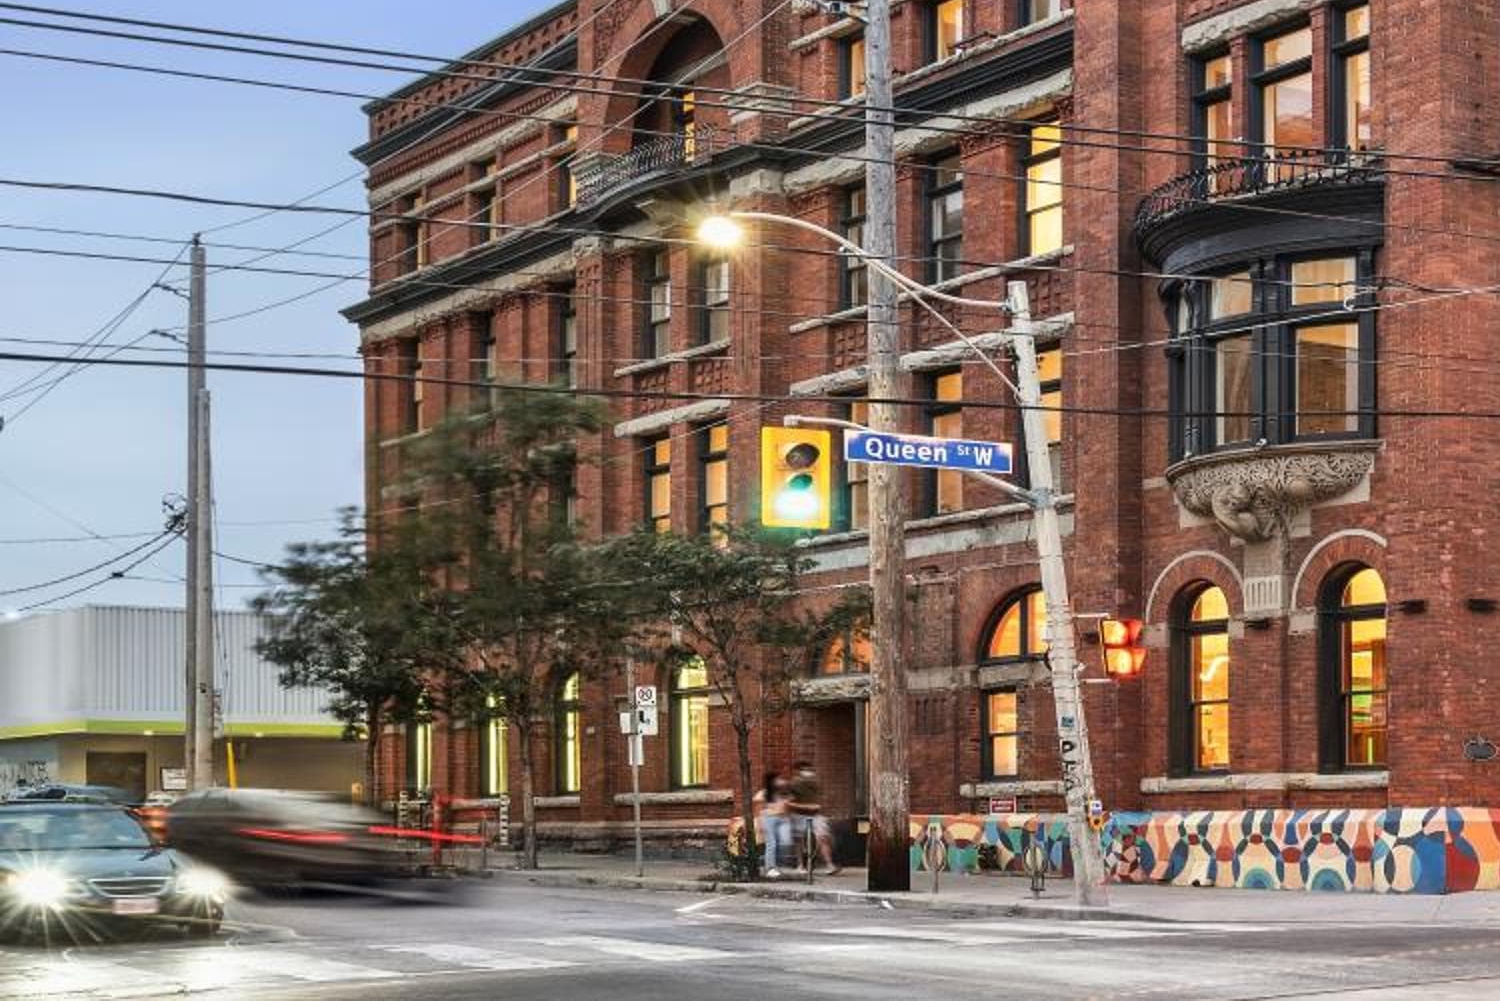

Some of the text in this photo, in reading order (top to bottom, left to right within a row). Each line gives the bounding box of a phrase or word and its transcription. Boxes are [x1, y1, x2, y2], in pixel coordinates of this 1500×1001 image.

[865, 437, 993, 466] Queen St W
